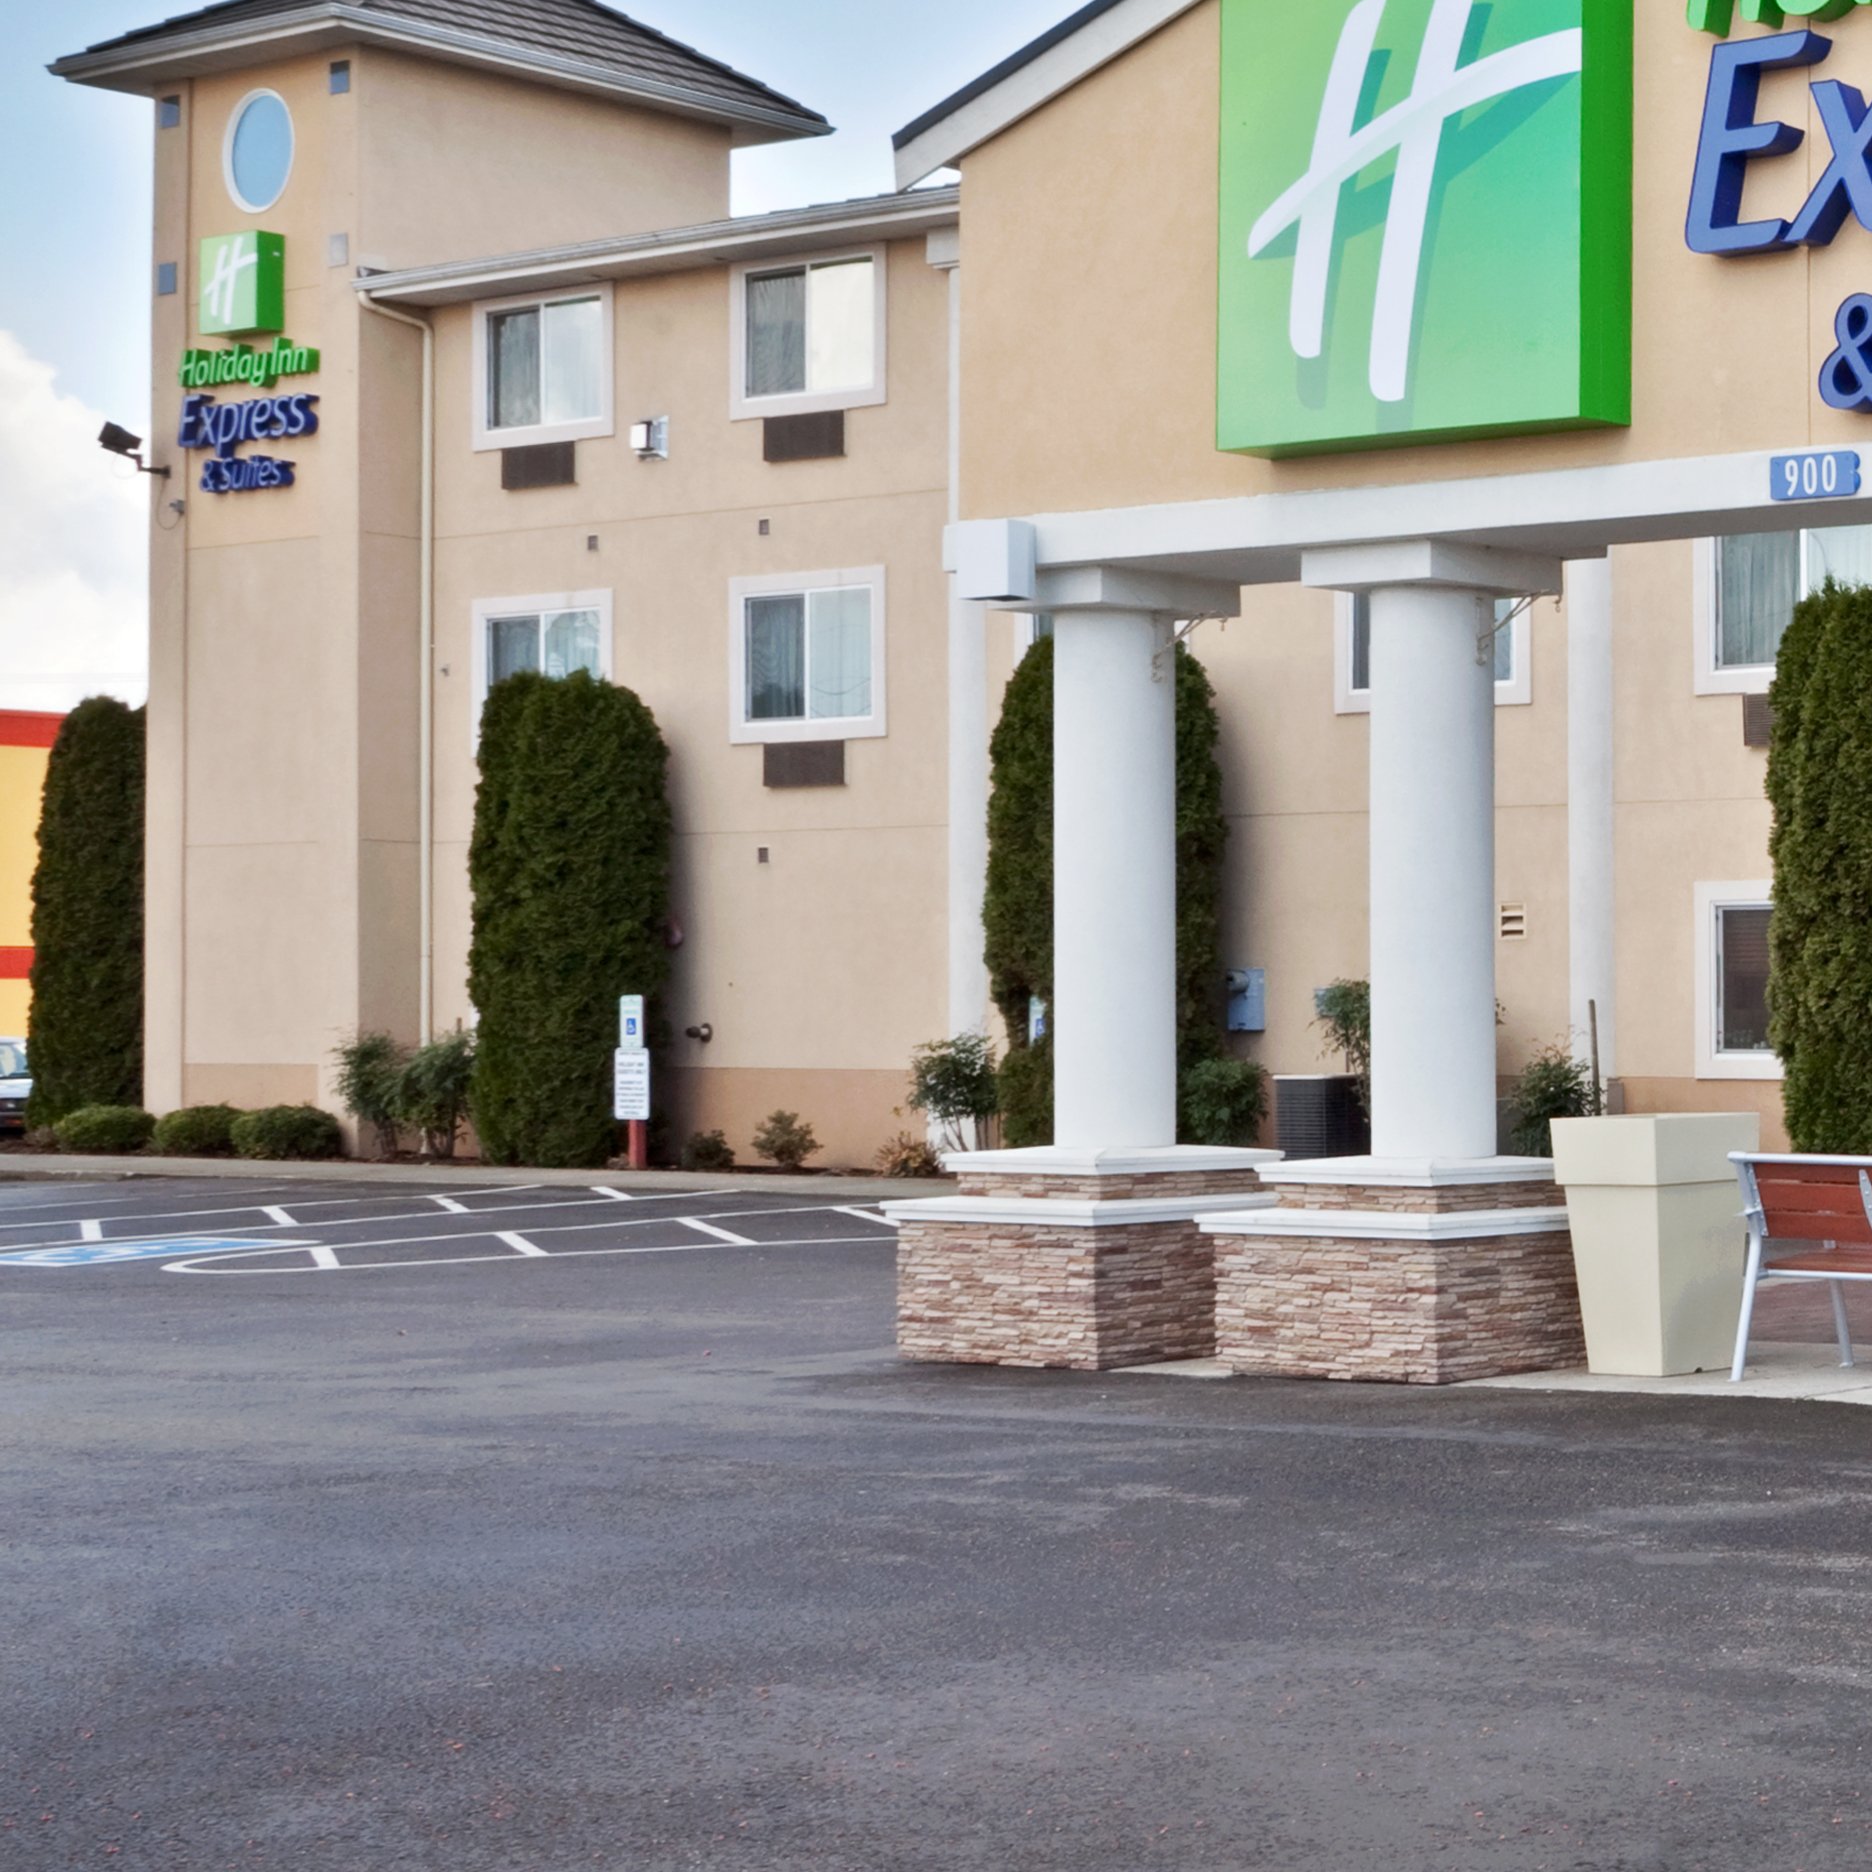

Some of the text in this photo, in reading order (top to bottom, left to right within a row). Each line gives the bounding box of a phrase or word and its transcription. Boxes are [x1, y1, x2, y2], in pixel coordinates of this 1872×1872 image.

[178, 336, 318, 388] Holiday Inn
[177, 392, 319, 457] Express
[200, 455, 295, 493] & Suites
[1784, 454, 1836, 497] 900
